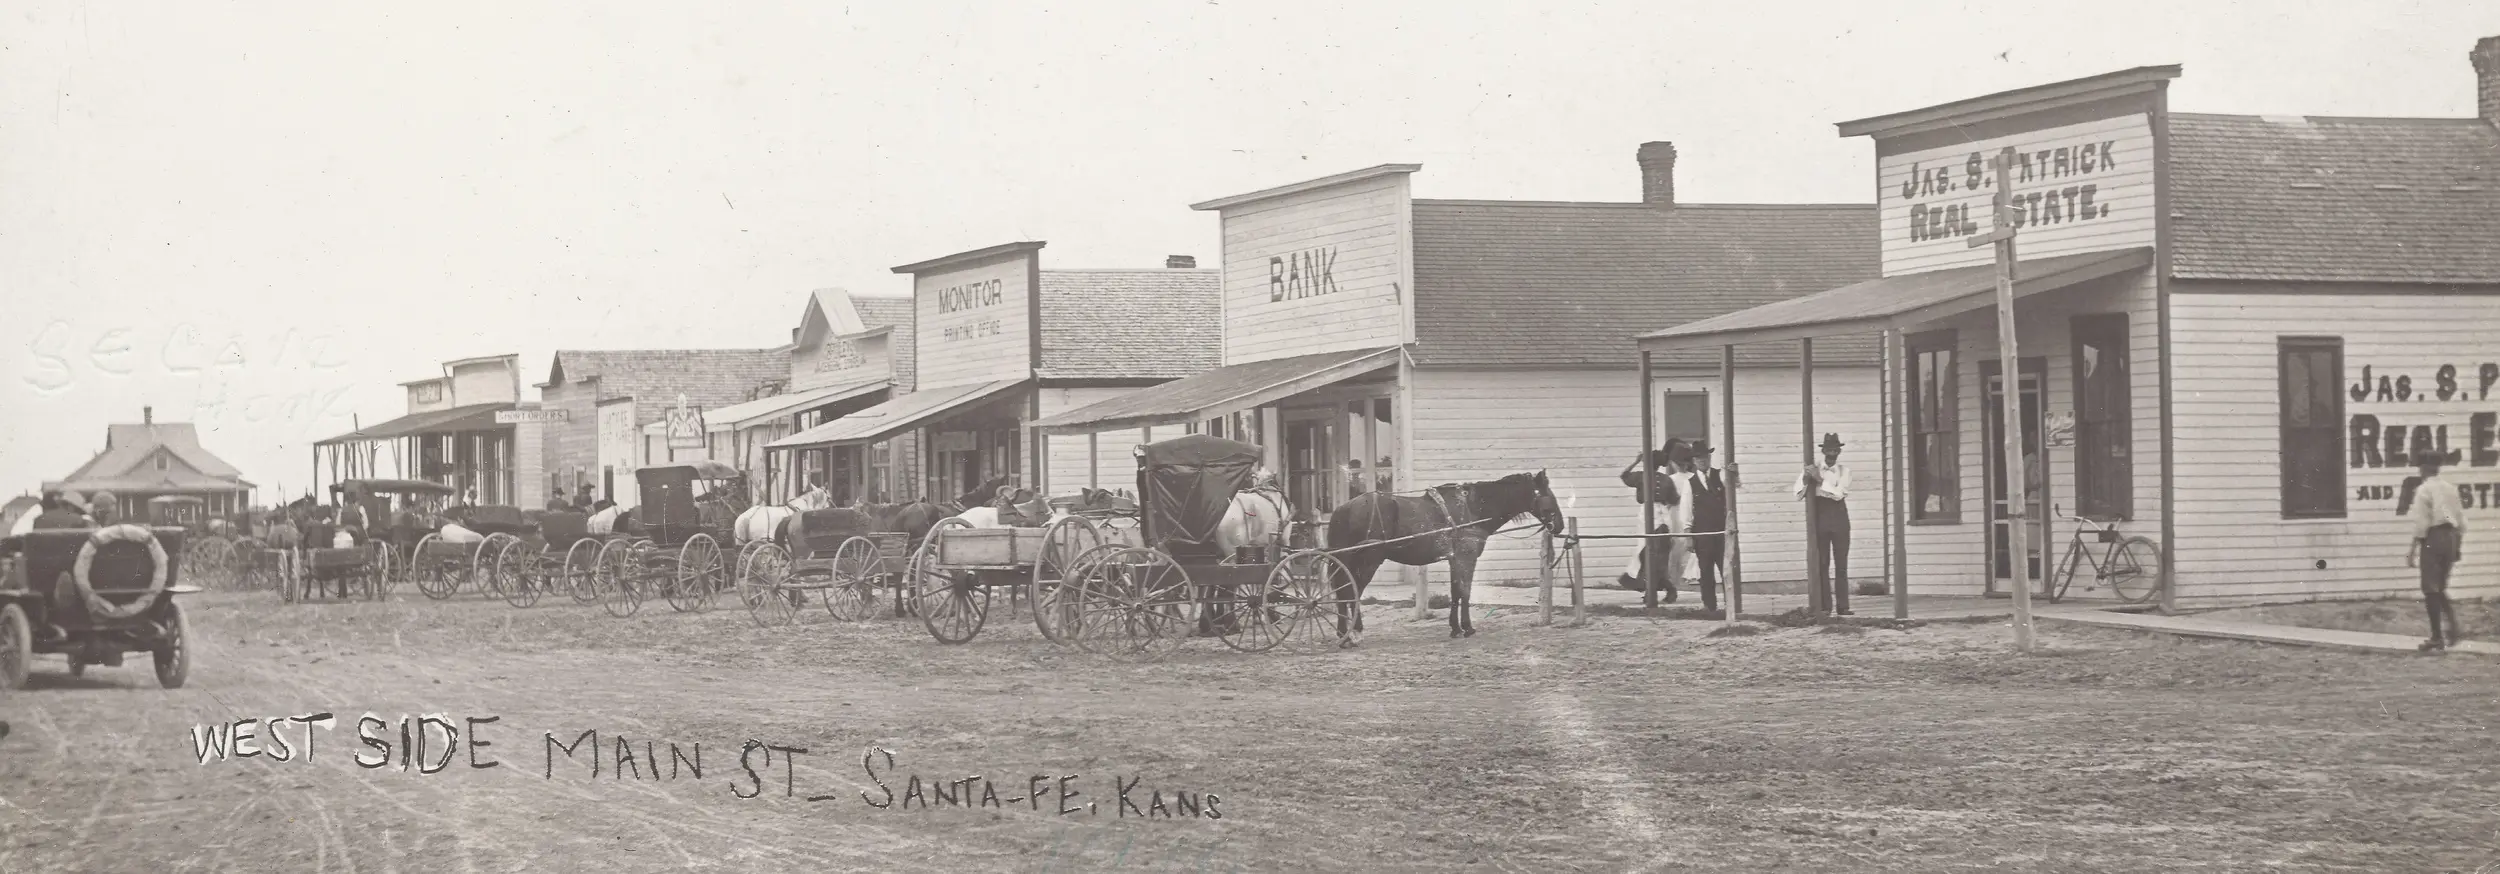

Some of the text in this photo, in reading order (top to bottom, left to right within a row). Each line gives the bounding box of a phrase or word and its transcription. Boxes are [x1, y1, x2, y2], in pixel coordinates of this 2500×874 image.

[1902, 162, 1956, 199] JAS.
[1966, 152, 1991, 190] S.
[1910, 203, 1978, 242] REAL
[938, 278, 1003, 315] MONITOR
[944, 319, 1001, 342] PRINTING OFFICE
[2350, 364, 2425, 402] JAS.
[2436, 363, 2468, 401] S.
[2349, 414, 2462, 468] REAL
[2357, 485, 2394, 501] AND
